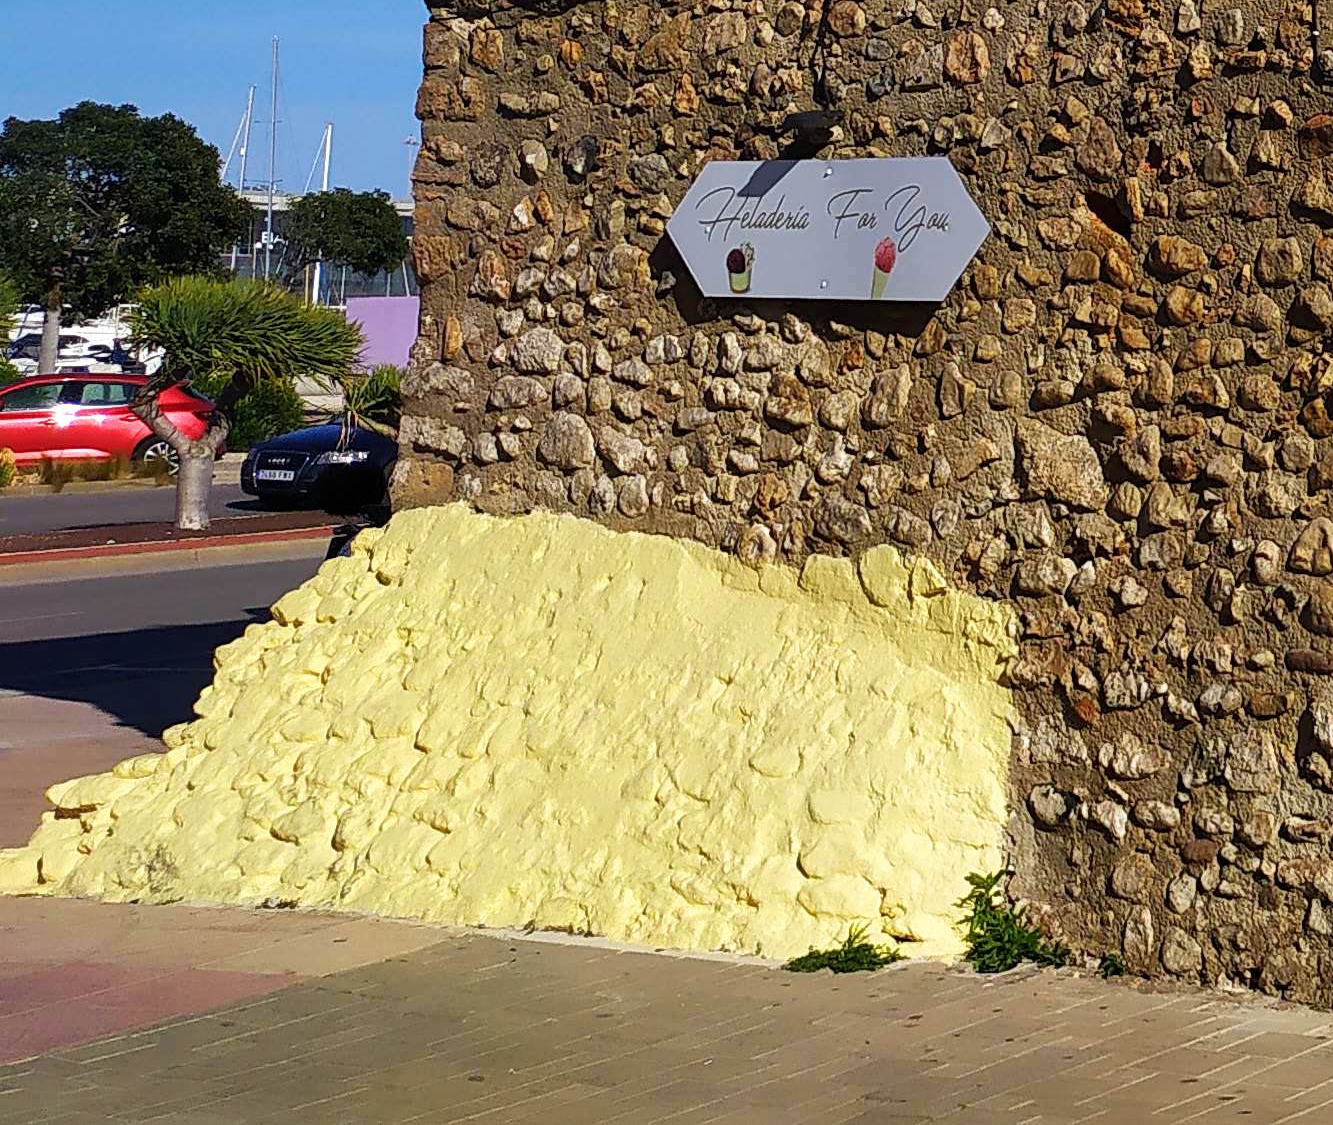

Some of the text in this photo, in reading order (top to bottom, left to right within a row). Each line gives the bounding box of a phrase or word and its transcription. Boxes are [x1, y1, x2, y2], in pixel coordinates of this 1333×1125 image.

[695, 185, 950, 253] Heladería For You
